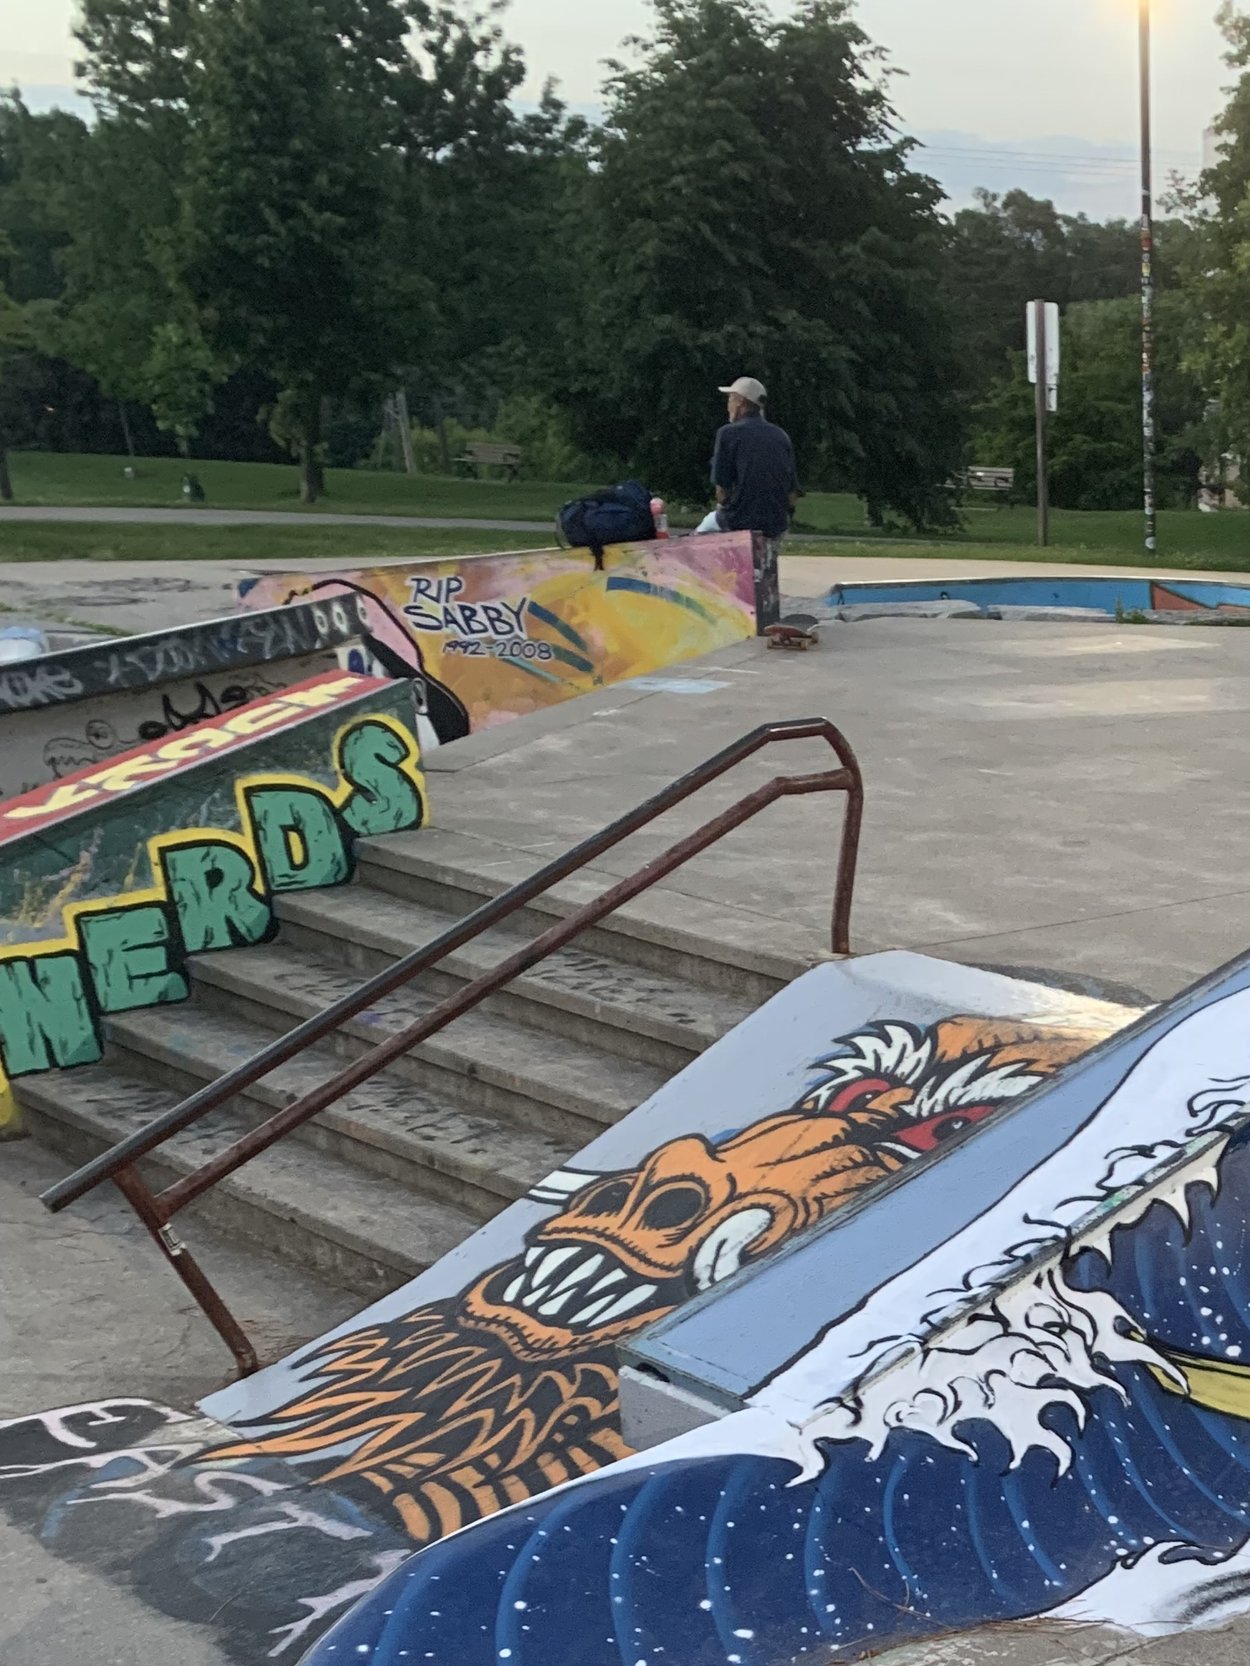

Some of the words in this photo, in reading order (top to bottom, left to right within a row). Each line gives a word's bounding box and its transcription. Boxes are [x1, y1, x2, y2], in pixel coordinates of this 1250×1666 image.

[410, 576, 463, 604] RIP
[403, 597, 527, 636] SABBY
[442, 640, 553, 660] 1992-2008
[0, 717, 427, 1079] NERDS
